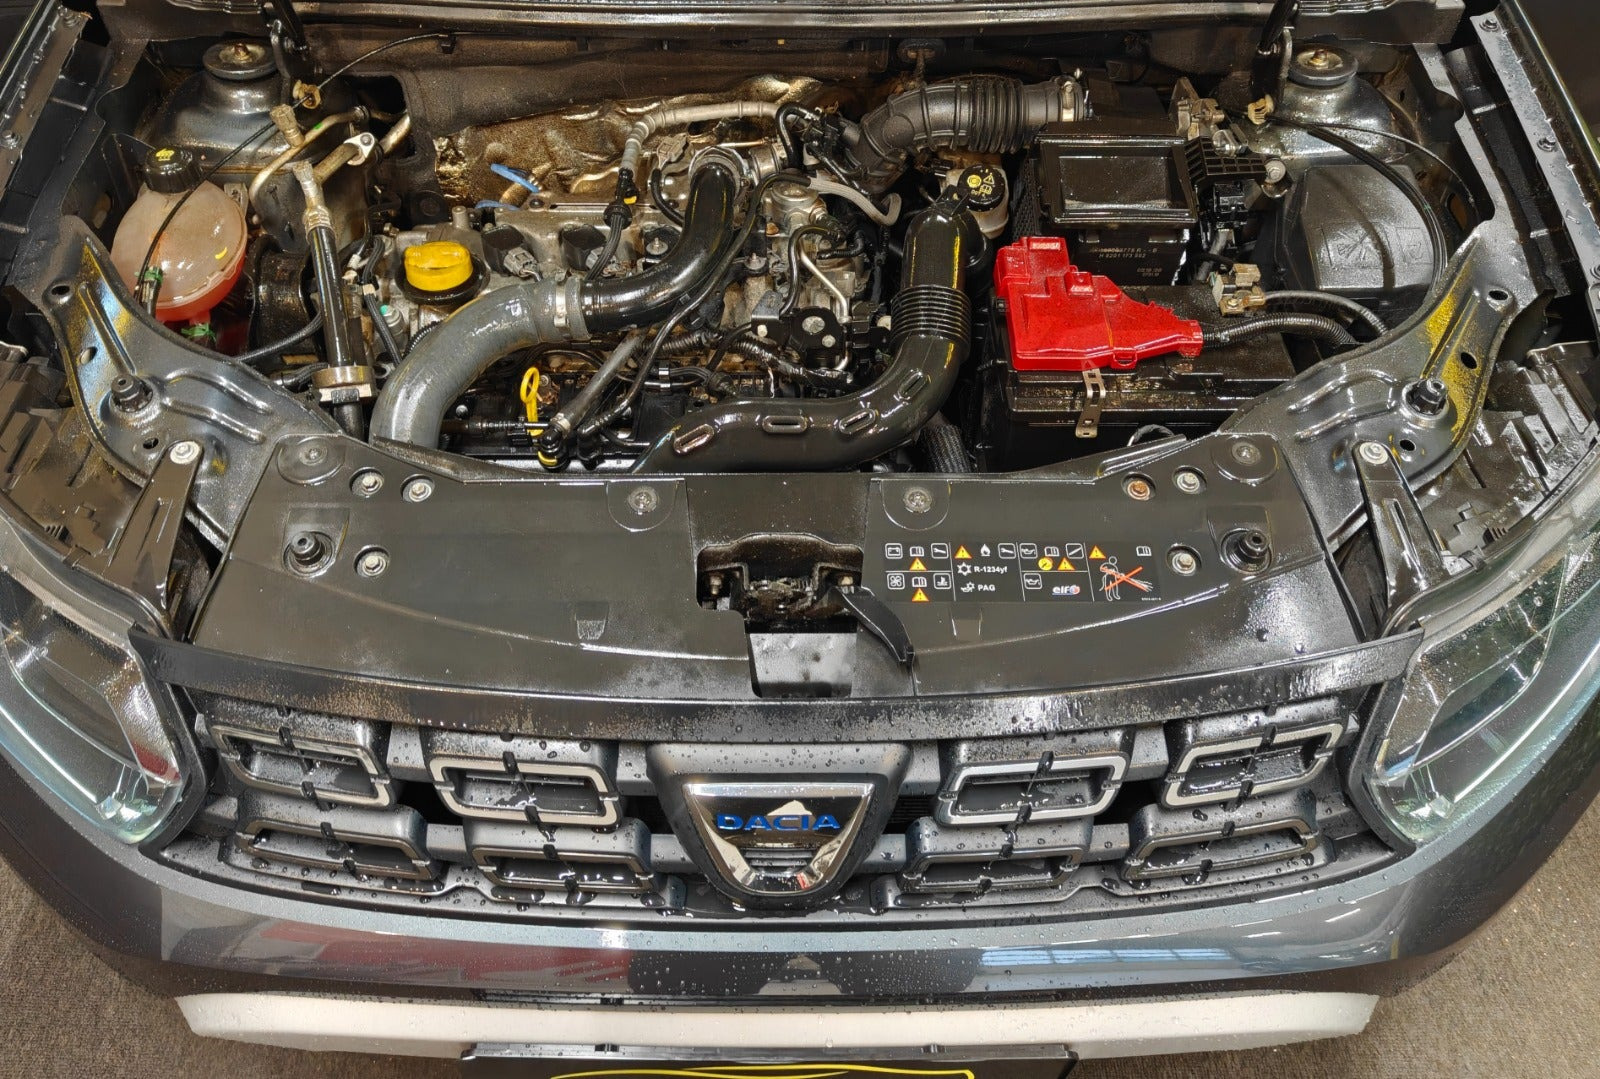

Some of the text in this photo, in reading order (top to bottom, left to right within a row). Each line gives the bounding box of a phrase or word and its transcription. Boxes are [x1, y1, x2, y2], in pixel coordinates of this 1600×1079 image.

[974, 565, 1008, 575] R-1234yf
[977, 584, 996, 592] PAG
[716, 813, 840, 831] DACIA
